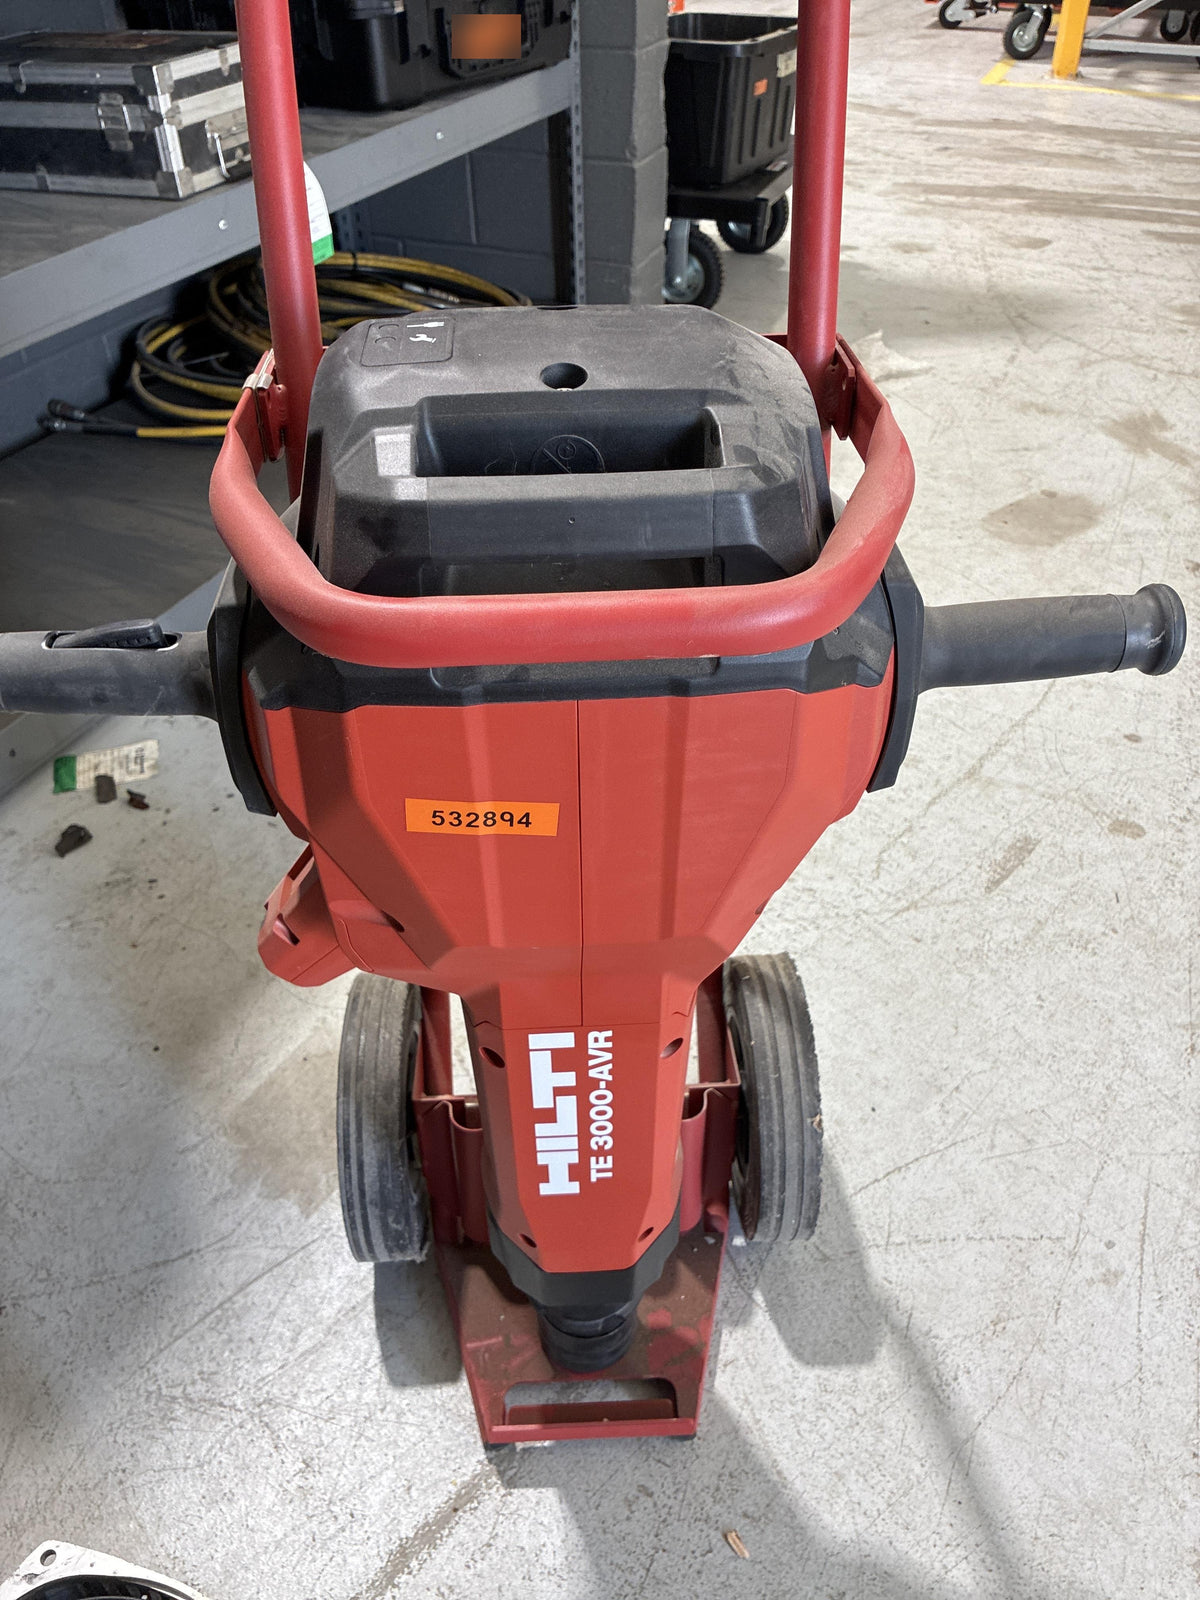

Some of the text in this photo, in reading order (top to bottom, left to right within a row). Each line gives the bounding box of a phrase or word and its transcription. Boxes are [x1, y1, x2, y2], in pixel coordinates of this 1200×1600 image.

[431, 809, 532, 828] 532894
[527, 1031, 581, 1196] HILTI
[587, 1029, 614, 1183] TE 3000-AVR
